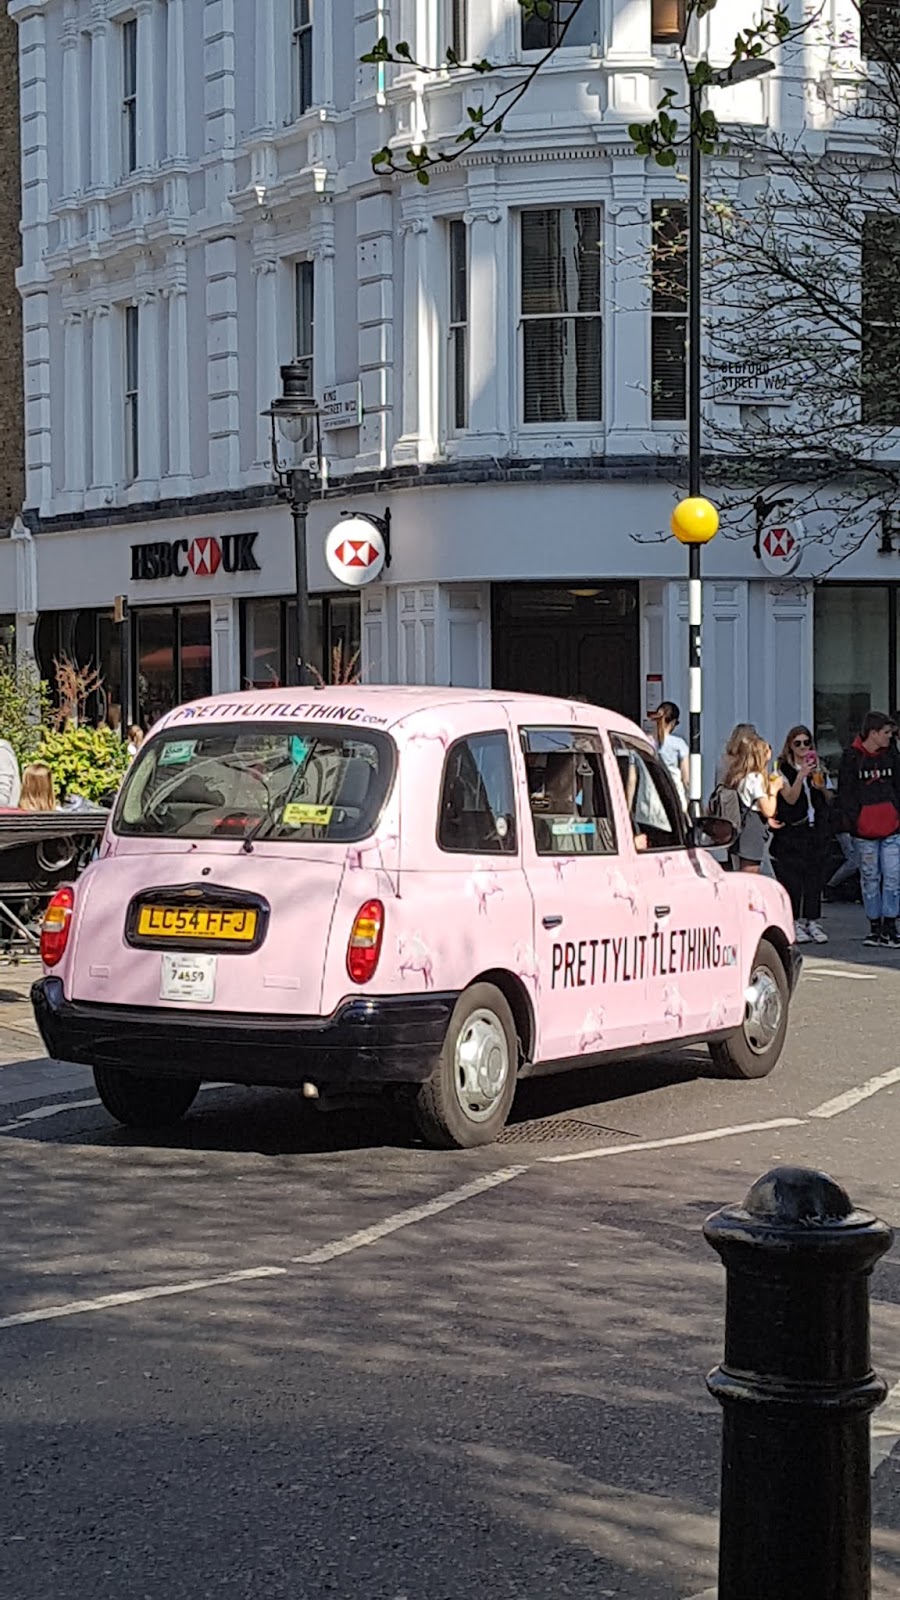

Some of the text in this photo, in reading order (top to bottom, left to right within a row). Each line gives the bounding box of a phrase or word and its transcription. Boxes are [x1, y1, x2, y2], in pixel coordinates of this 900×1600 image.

[721, 376, 759, 389] STREET
[130, 532, 261, 580] HSBC UK
[148, 907, 247, 932] LC54 FFJ
